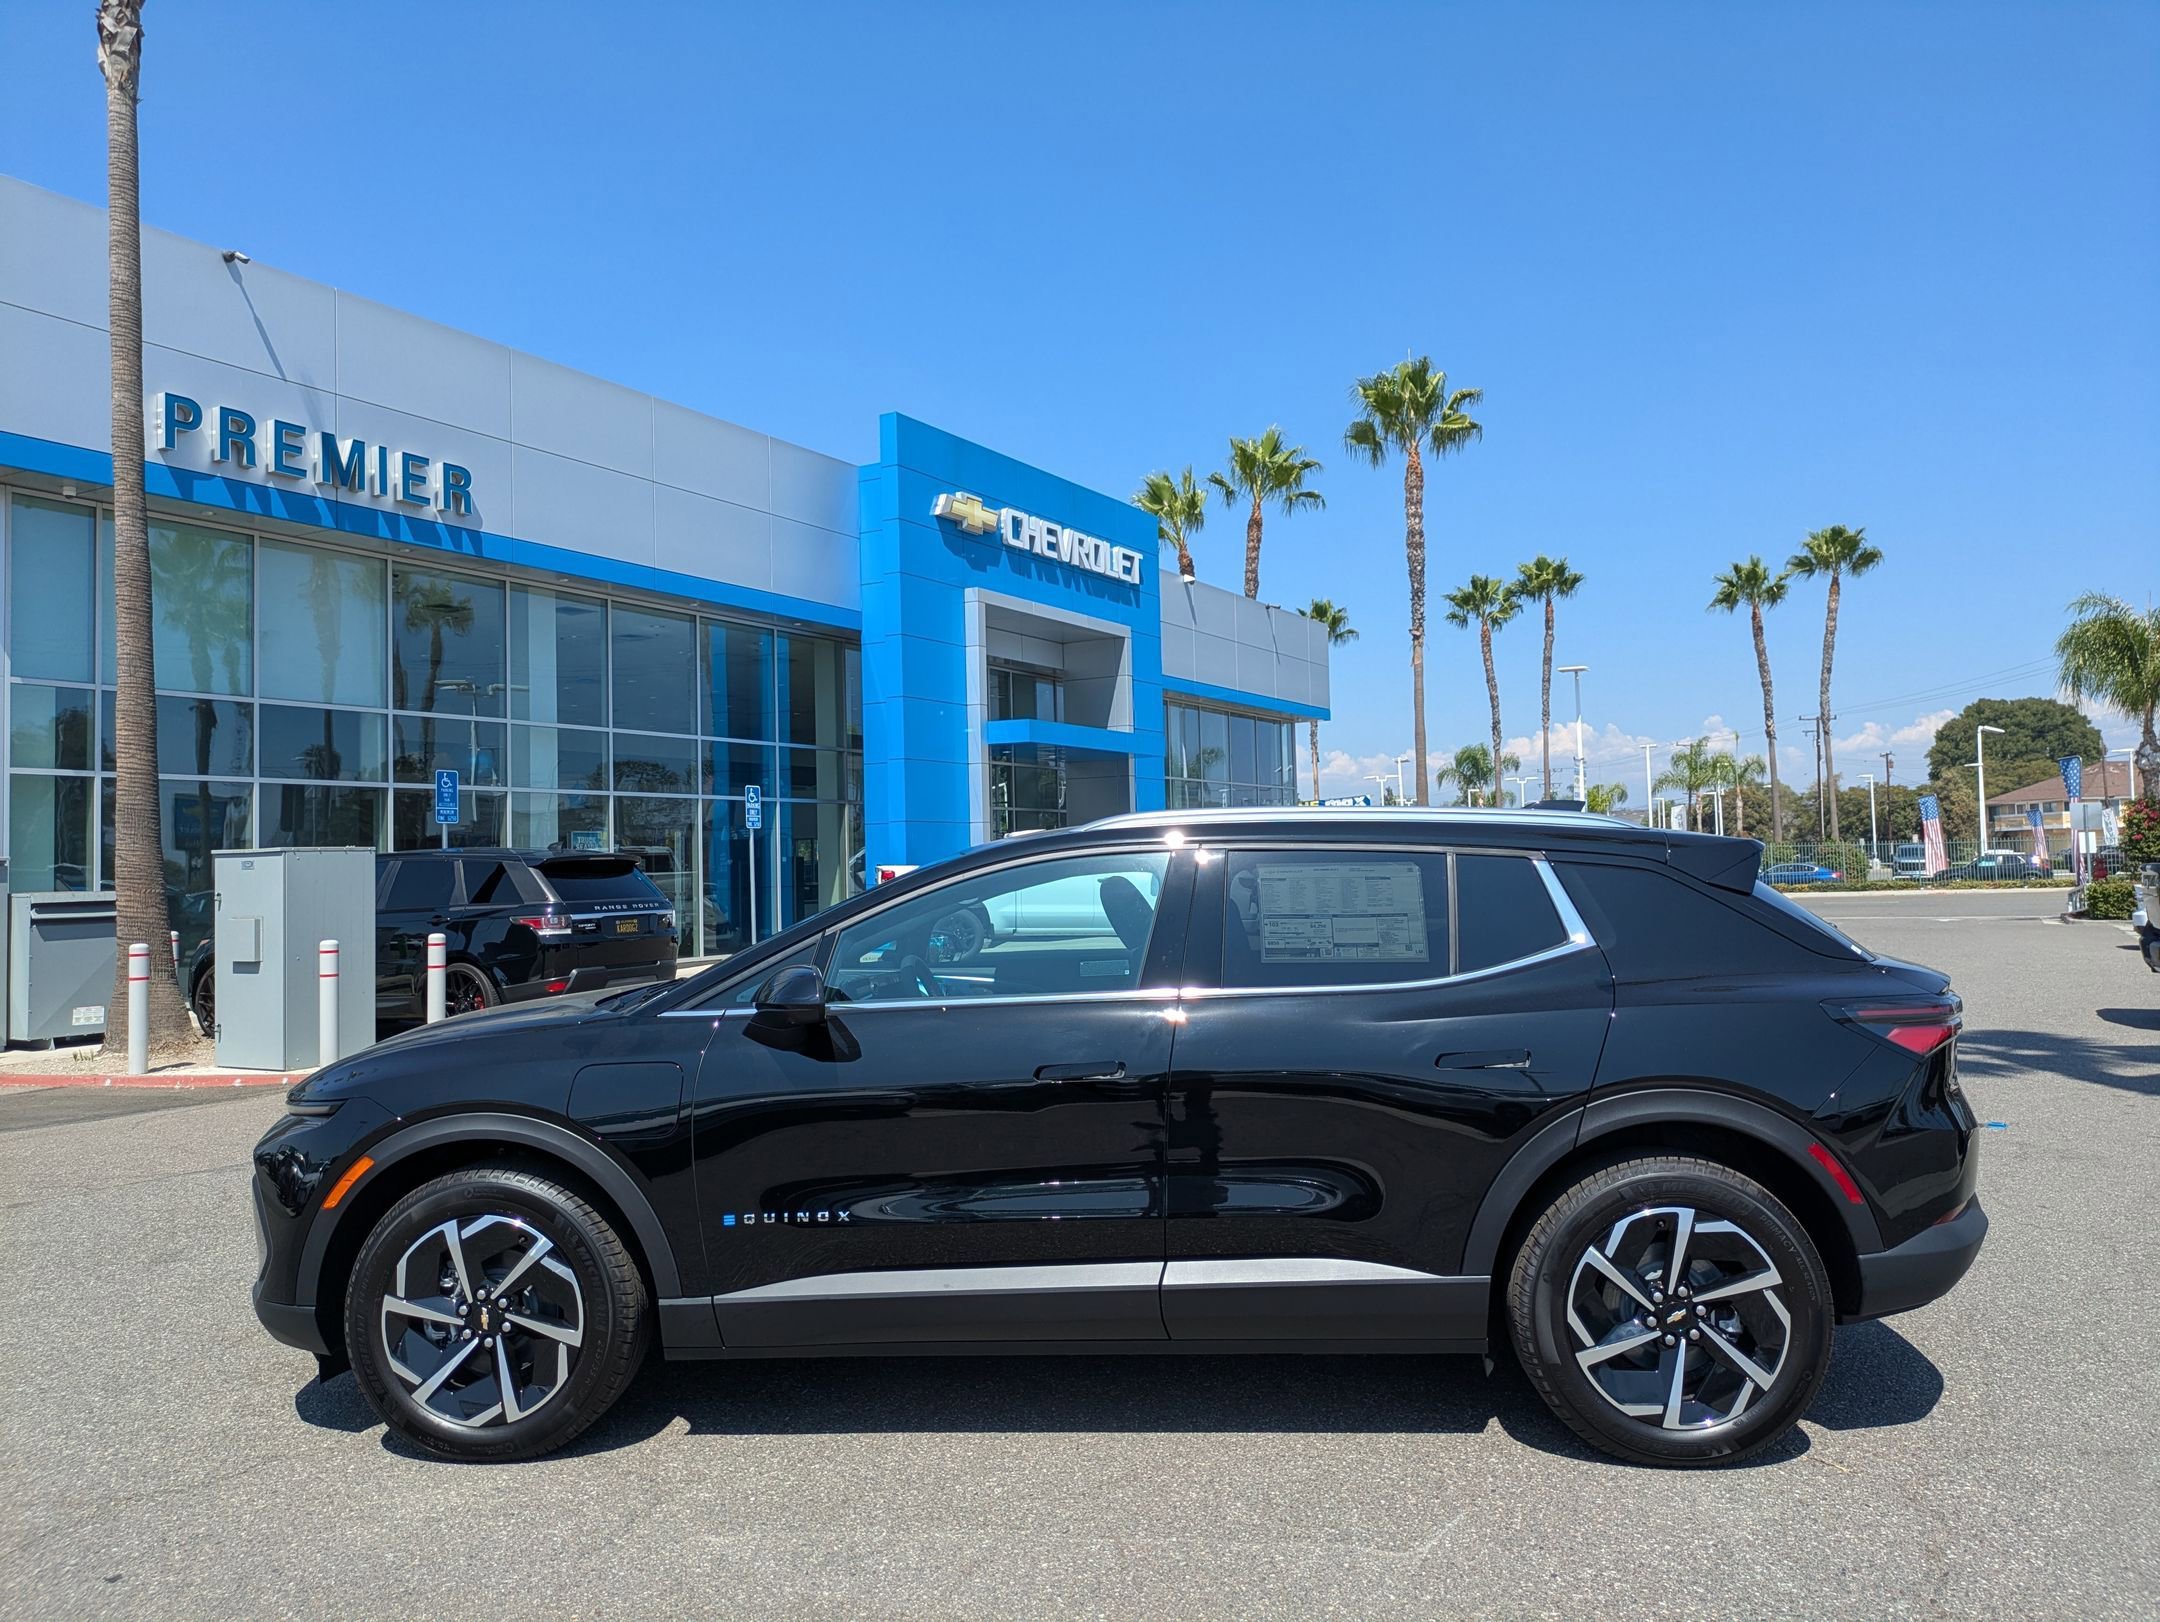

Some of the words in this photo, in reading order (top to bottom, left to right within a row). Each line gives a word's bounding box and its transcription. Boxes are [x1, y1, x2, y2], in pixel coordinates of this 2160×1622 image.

[157, 392, 474, 515] PREMIER
[1001, 507, 1143, 584] CHEVROLET
[723, 1211, 850, 1226] EQUINOX
[1760, 1214, 1798, 1253] PRIMACY
